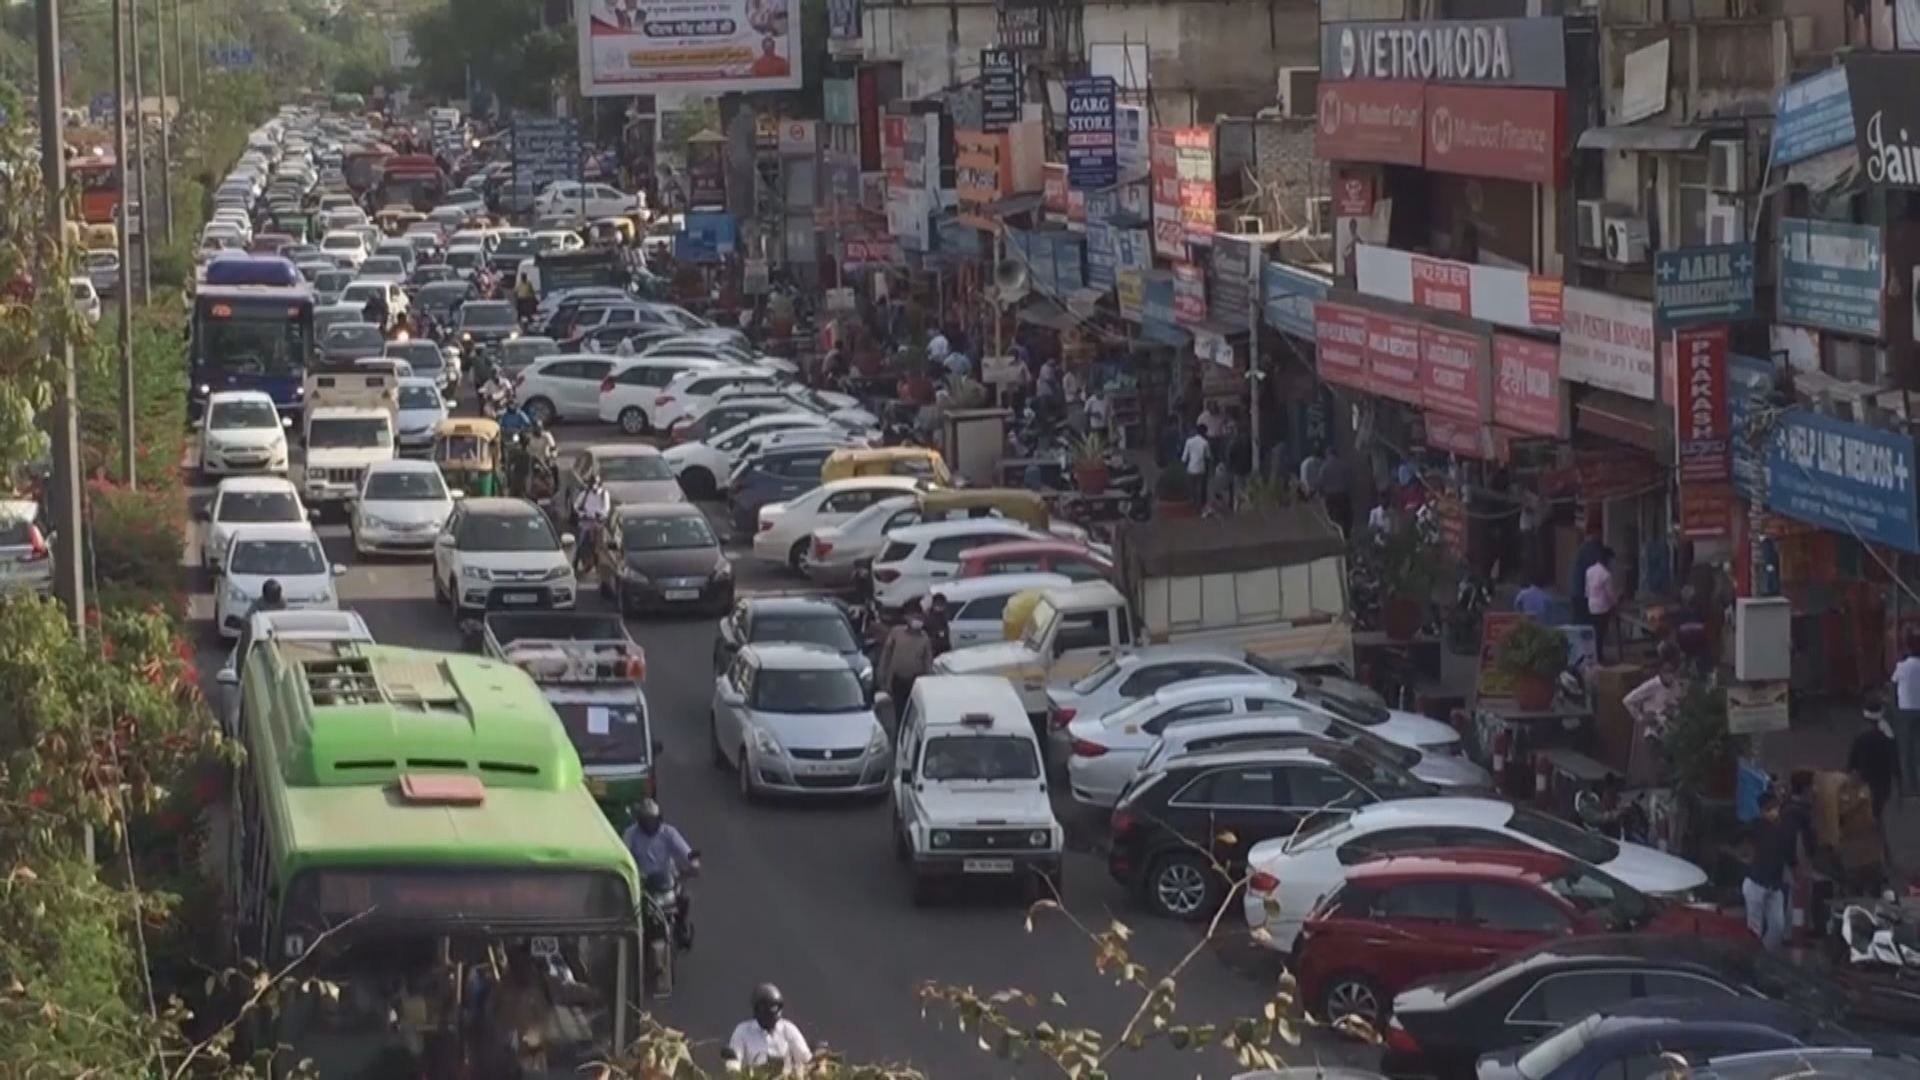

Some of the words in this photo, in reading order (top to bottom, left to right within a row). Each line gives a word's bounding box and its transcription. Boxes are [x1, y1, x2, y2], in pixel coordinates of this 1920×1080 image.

[1360, 26, 1509, 79] VETROMODA
[1070, 97, 1109, 113] GARG
[1069, 116, 1112, 131] STORE
[1502, 119, 1546, 153] Finance
[1679, 253, 1731, 281] AARK
[1690, 340, 1712, 440] PRAKASH
[1789, 424, 1815, 468] HELP
[1817, 428, 1843, 477] LINE
[1844, 436, 1894, 491] MEDICOS
